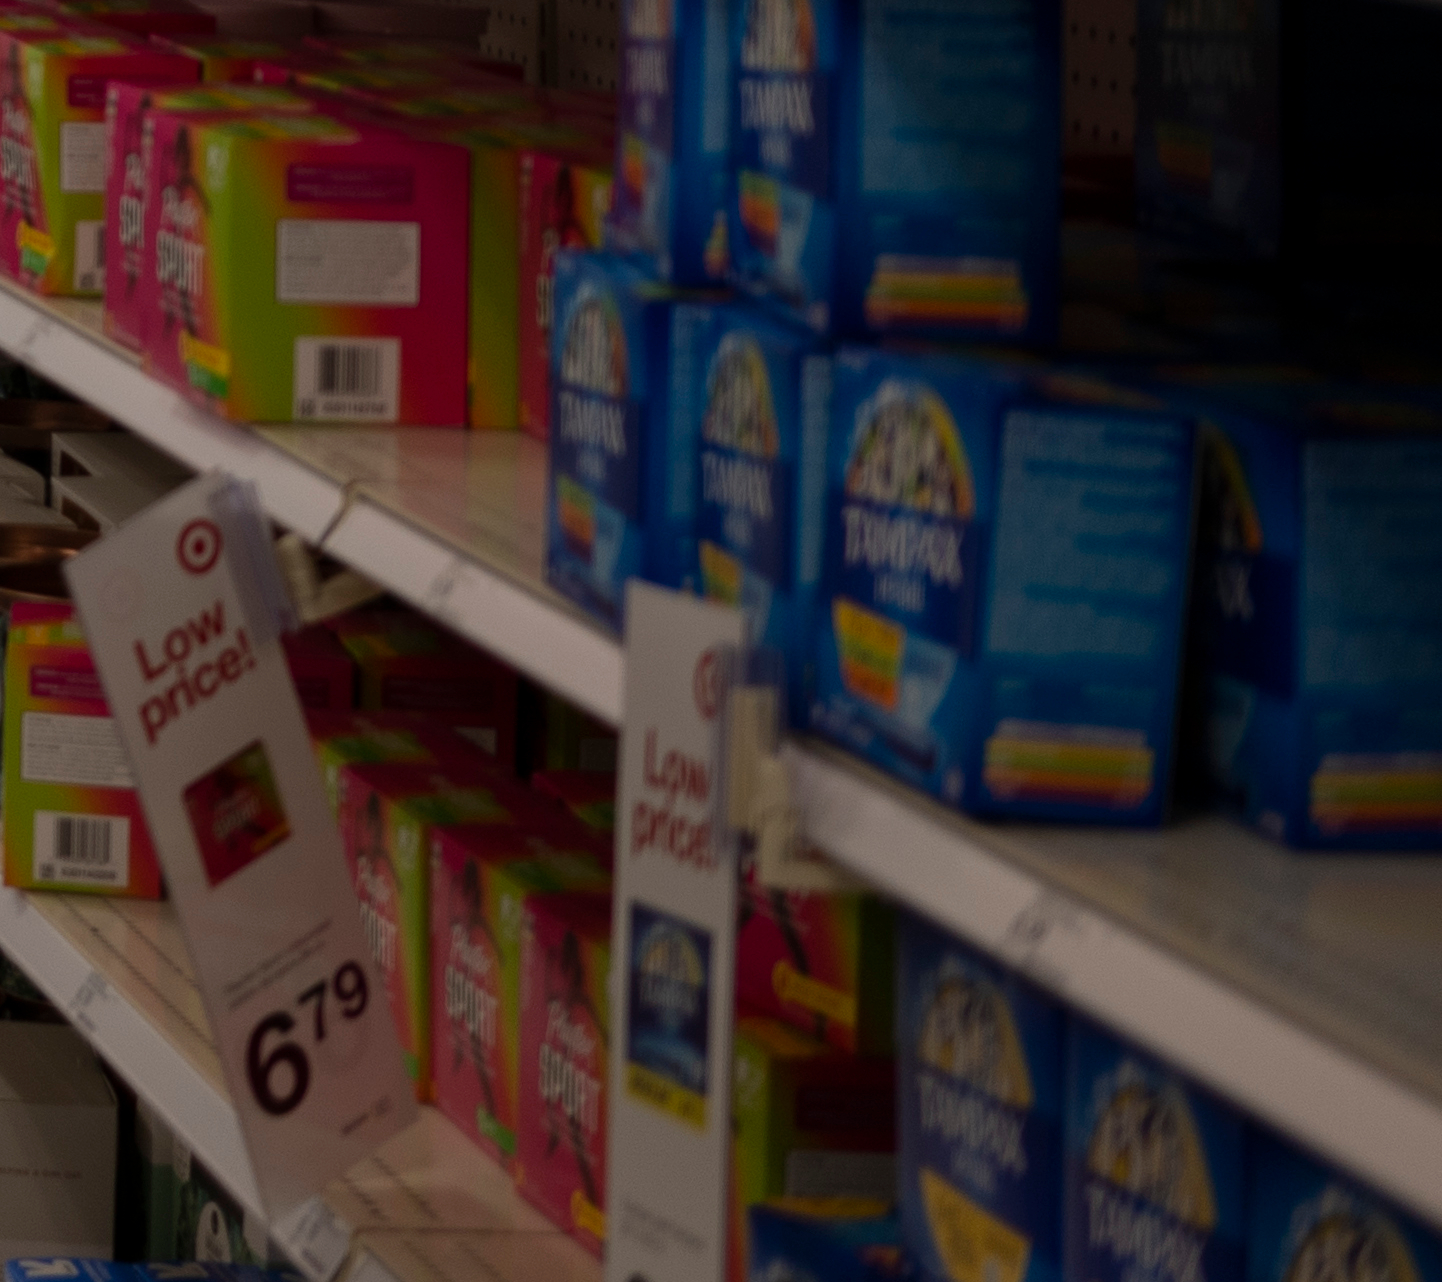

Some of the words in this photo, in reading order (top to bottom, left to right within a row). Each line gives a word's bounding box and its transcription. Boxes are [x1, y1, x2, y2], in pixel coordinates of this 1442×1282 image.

[156, 229, 206, 296] SPORT
[842, 503, 964, 591] TAMPAX
[133, 599, 227, 686] Low
[136, 630, 256, 747] price!
[538, 1039, 602, 1125] SPORT
[918, 1072, 1029, 1177] TAMPAX
